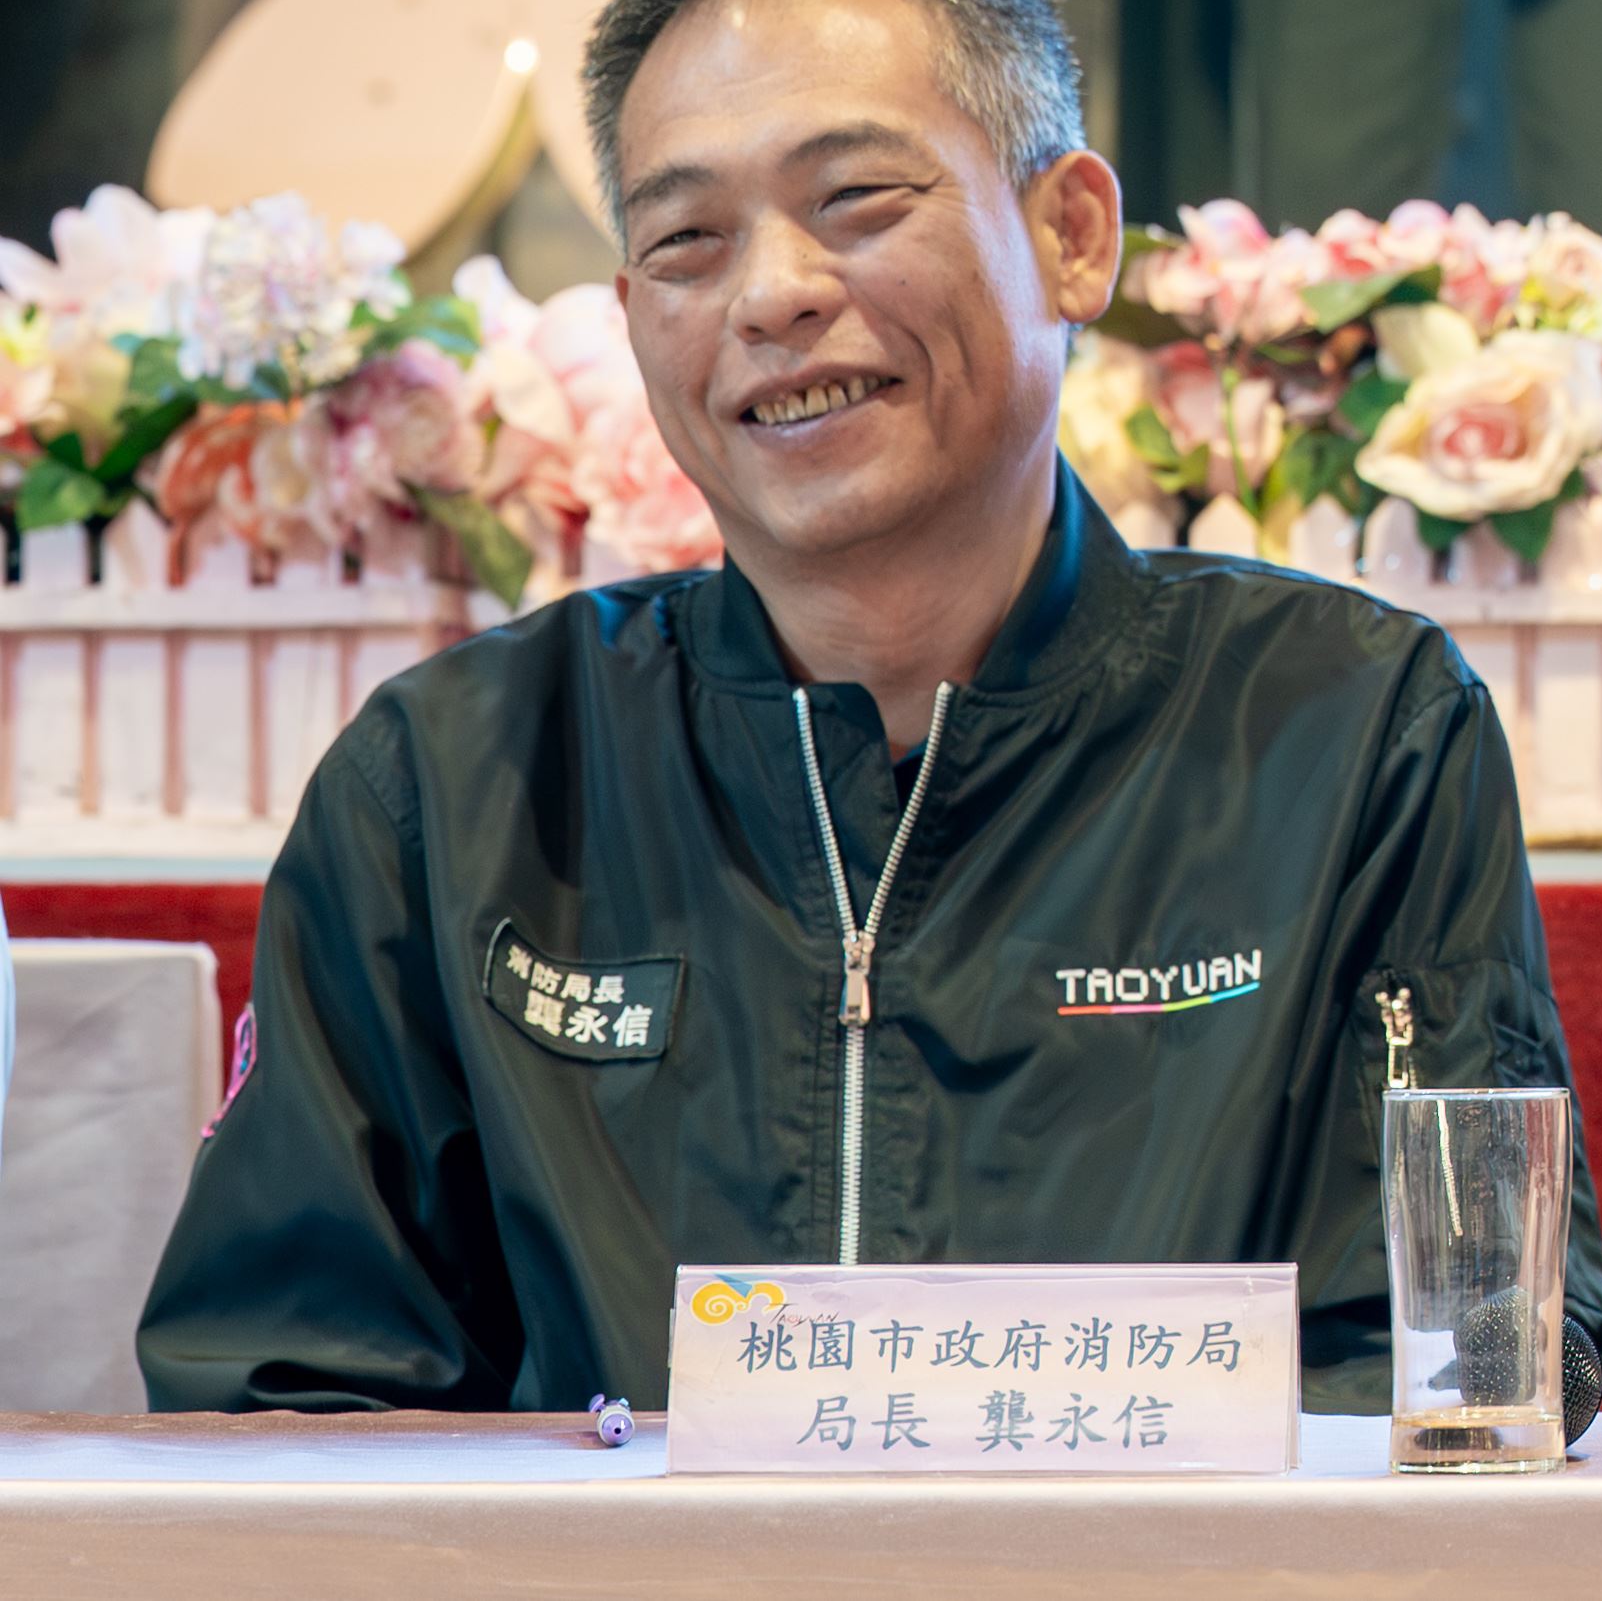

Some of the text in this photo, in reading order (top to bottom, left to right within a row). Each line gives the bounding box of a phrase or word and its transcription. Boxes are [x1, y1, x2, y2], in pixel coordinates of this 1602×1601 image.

[506, 945, 625, 1004] 消防局長
[1056, 949, 1262, 1004] TAOYUAN
[736, 1317, 1242, 1374] 桃園市政府消防局
[796, 1388, 1175, 1453] 局長 龔永信
